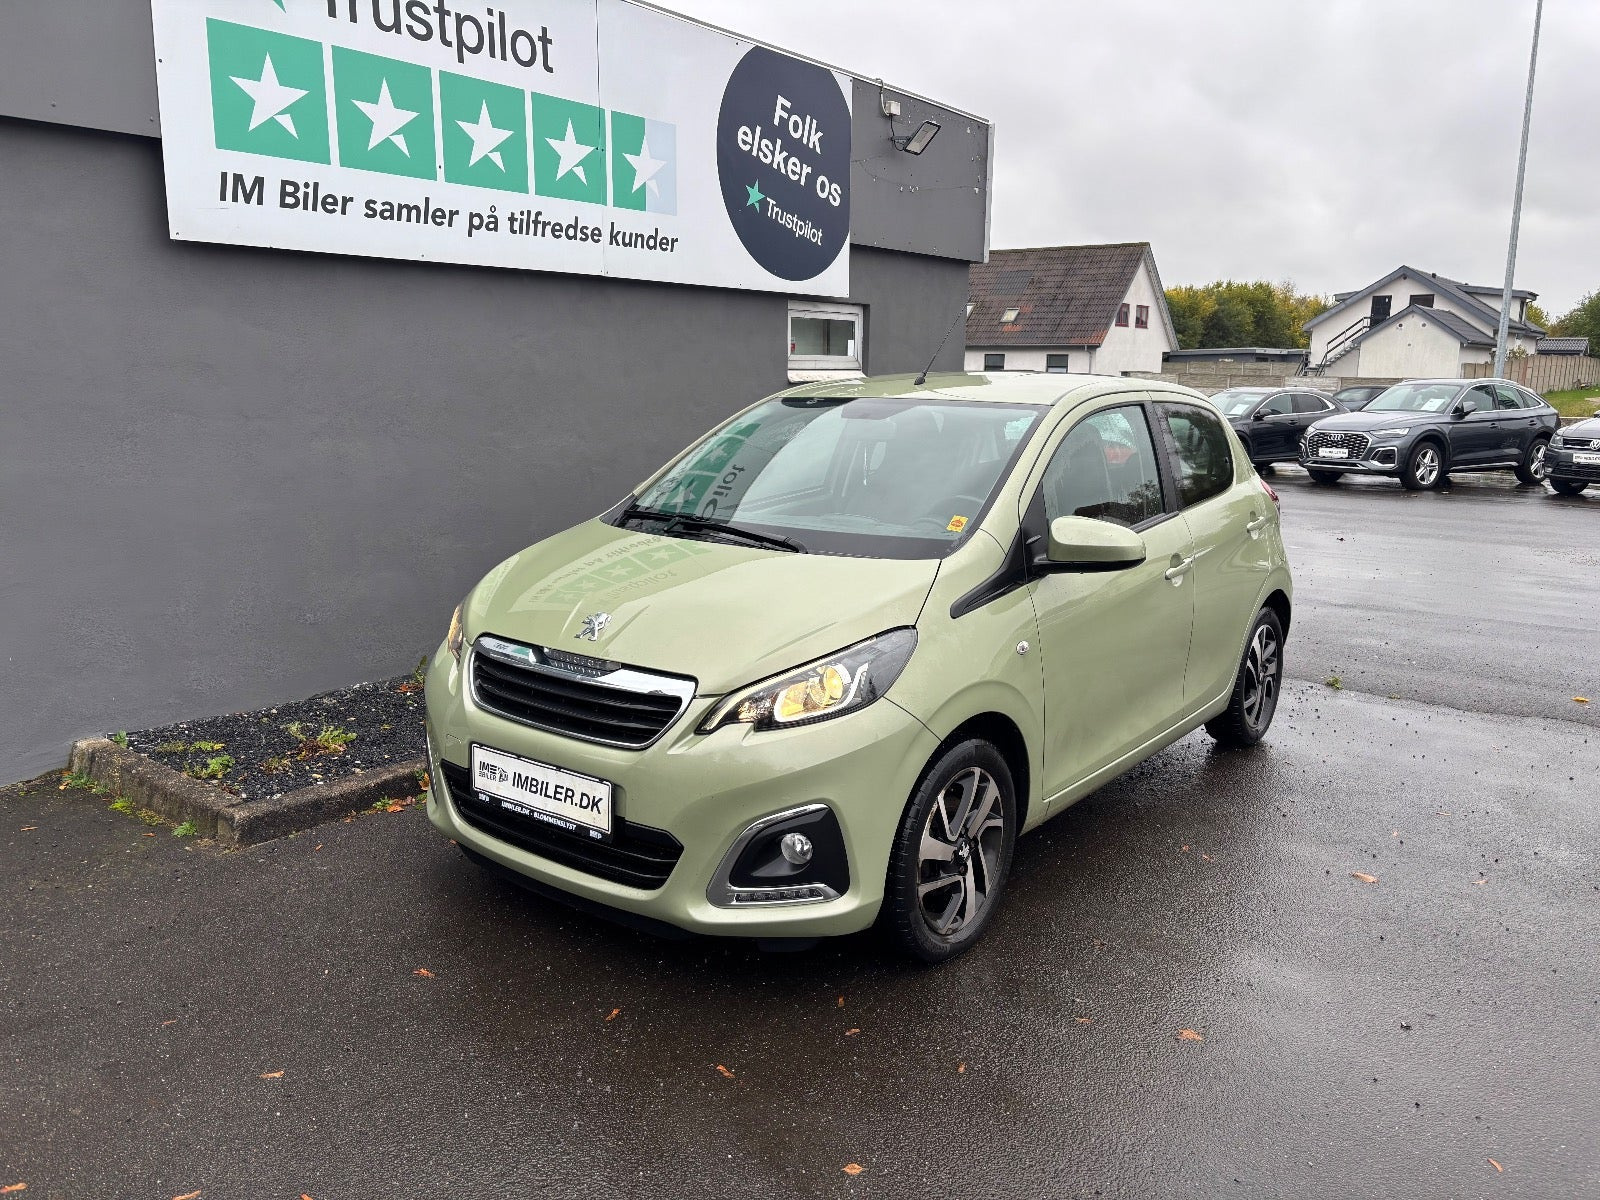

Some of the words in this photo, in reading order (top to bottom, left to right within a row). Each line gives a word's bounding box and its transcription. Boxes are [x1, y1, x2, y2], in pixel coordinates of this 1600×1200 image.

[773, 94, 823, 154] Folk
[737, 125, 812, 186] elsker
[816, 175, 842, 207] os
[219, 171, 265, 206] IM
[279, 178, 354, 216] Biler
[363, 196, 460, 228] samler
[467, 204, 499, 238] på
[507, 209, 602, 244] tilfredse
[609, 221, 679, 253] kunder
[766, 196, 823, 246] Trustpilot
[512, 771, 604, 815] IMBILER.DK
